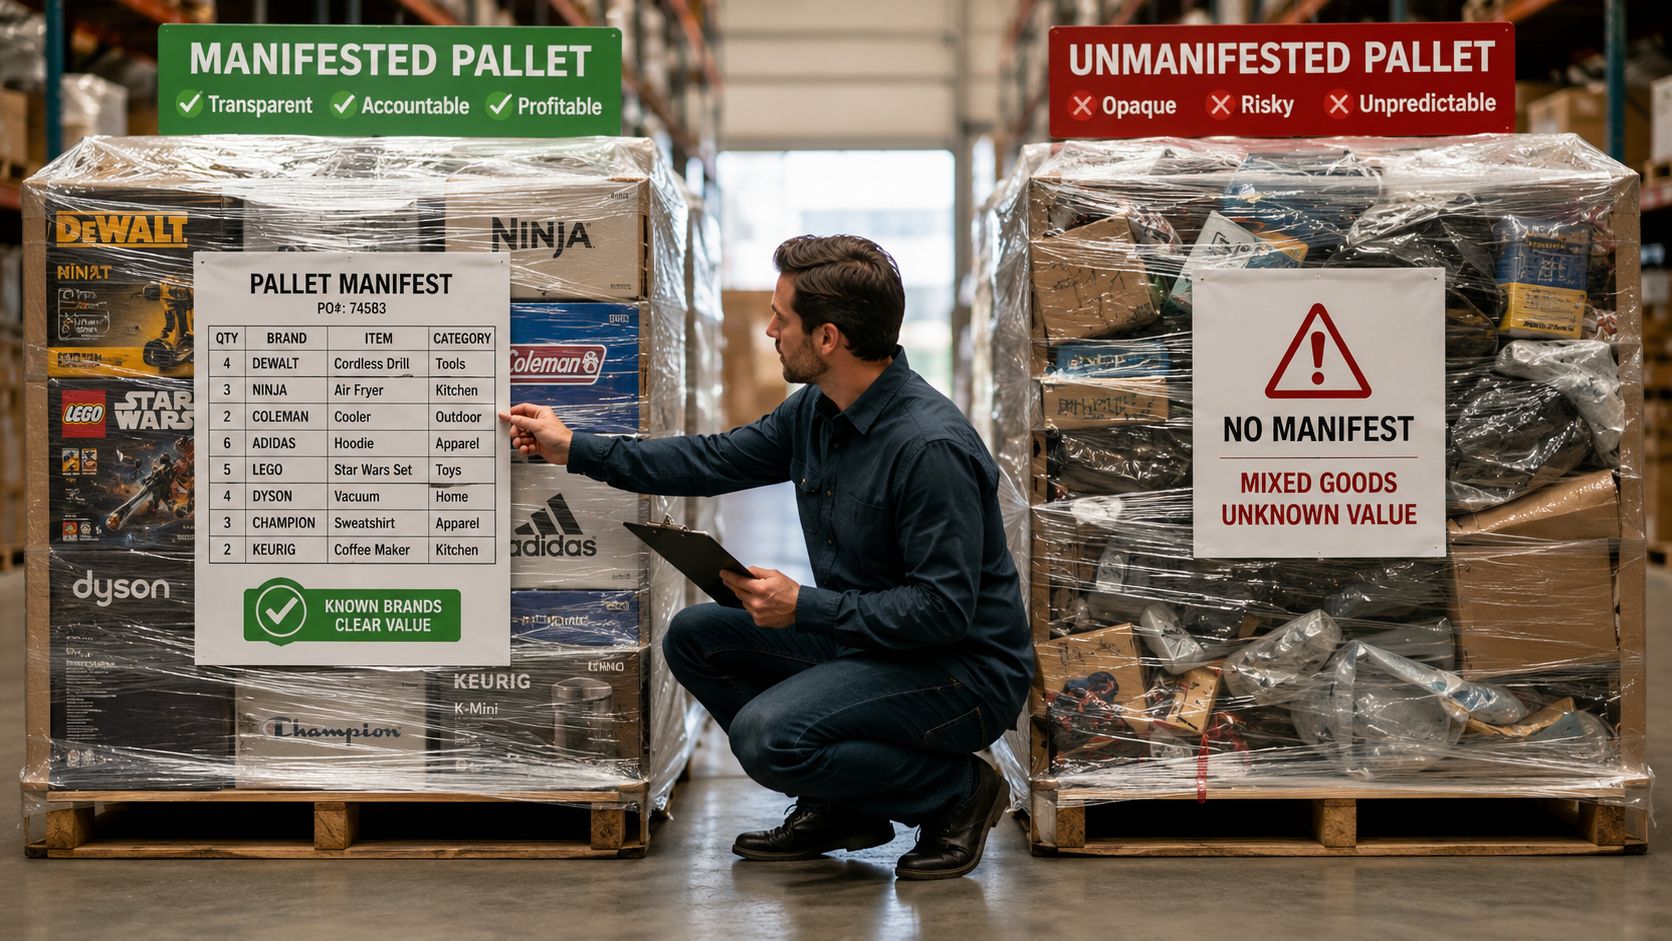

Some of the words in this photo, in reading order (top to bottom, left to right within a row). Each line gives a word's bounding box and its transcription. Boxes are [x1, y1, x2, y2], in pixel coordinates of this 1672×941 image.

[190, 42, 437, 76] MANIFESTED
[452, 44, 592, 77] PALLET
[1069, 41, 1351, 77] UNMANIFESTED
[1364, 40, 1496, 74] PALLET
[208, 95, 313, 118] Transparent
[361, 95, 470, 115] Accountable
[518, 96, 603, 116] Profitable
[1102, 95, 1177, 120] Opaque
[1241, 93, 1295, 119] Risky
[1359, 91, 1497, 118] Unpredictable
[250, 272, 332, 295] PALLET
[339, 272, 453, 295] MANIFEST
[349, 301, 387, 316] 74583
[215, 331, 239, 346] QTY
[266, 331, 308, 345] BRAND
[364, 331, 393, 345] ITEM
[433, 332, 492, 345] CATEGORY
[223, 356, 231, 370] 4
[252, 356, 300, 370] DEWALT
[334, 356, 384, 370] Cordless
[386, 356, 410, 370] Drill
[435, 357, 466, 370] Tools
[223, 383, 231, 396] 3
[252, 383, 288, 397] NINJA
[333, 383, 352, 397] Air
[354, 383, 385, 399] Fryer
[435, 383, 479, 397] Kitchen
[114, 391, 194, 410] STAR
[65, 405, 103, 422] LEGO
[114, 411, 194, 429] WARS
[223, 409, 231, 423] 2
[252, 409, 309, 423] COLEMAN
[334, 409, 372, 423] Cooler
[435, 410, 483, 423] Outdoor
[1223, 415, 1263, 443] NO
[1272, 415, 1415, 443] MANIFEST
[223, 436, 232, 449] 6
[251, 436, 297, 450] ADIDAS
[334, 436, 375, 450] Hoodie
[435, 436, 480, 453] Apparel
[223, 462, 232, 476] 5
[252, 462, 283, 476] LEGO
[334, 463, 359, 476] Star
[360, 463, 391, 476] Wars
[393, 463, 413, 476] Set
[435, 463, 462, 479] Toys
[1240, 471, 1312, 494] MIXED
[1319, 471, 1398, 494] GOODS
[223, 489, 232, 502] 4
[252, 489, 293, 503] DYSON
[333, 489, 380, 503] Vacuum
[435, 489, 469, 503] Home
[1221, 503, 1340, 526] UNKNOWN
[1346, 503, 1418, 526] VALUE
[223, 516, 231, 529] 3
[252, 516, 316, 529] CHAMPION
[334, 516, 396, 529] Sweatshirt
[435, 516, 480, 533] Apparel
[223, 542, 232, 556] 2
[252, 542, 296, 556] KEURIG
[333, 542, 372, 556] Coffee
[374, 543, 411, 556] Maker
[435, 543, 479, 556] Kitchen
[511, 535, 597, 557] adidas
[73, 570, 170, 607] dyson
[325, 599, 379, 614] KNOWN
[383, 599, 442, 614] BRANDS
[335, 617, 382, 632] CLEAR
[385, 617, 432, 632] VALUE
[454, 674, 531, 689] KEURIG
[454, 702, 498, 715] K-Mini
[262, 716, 402, 747] Champion
